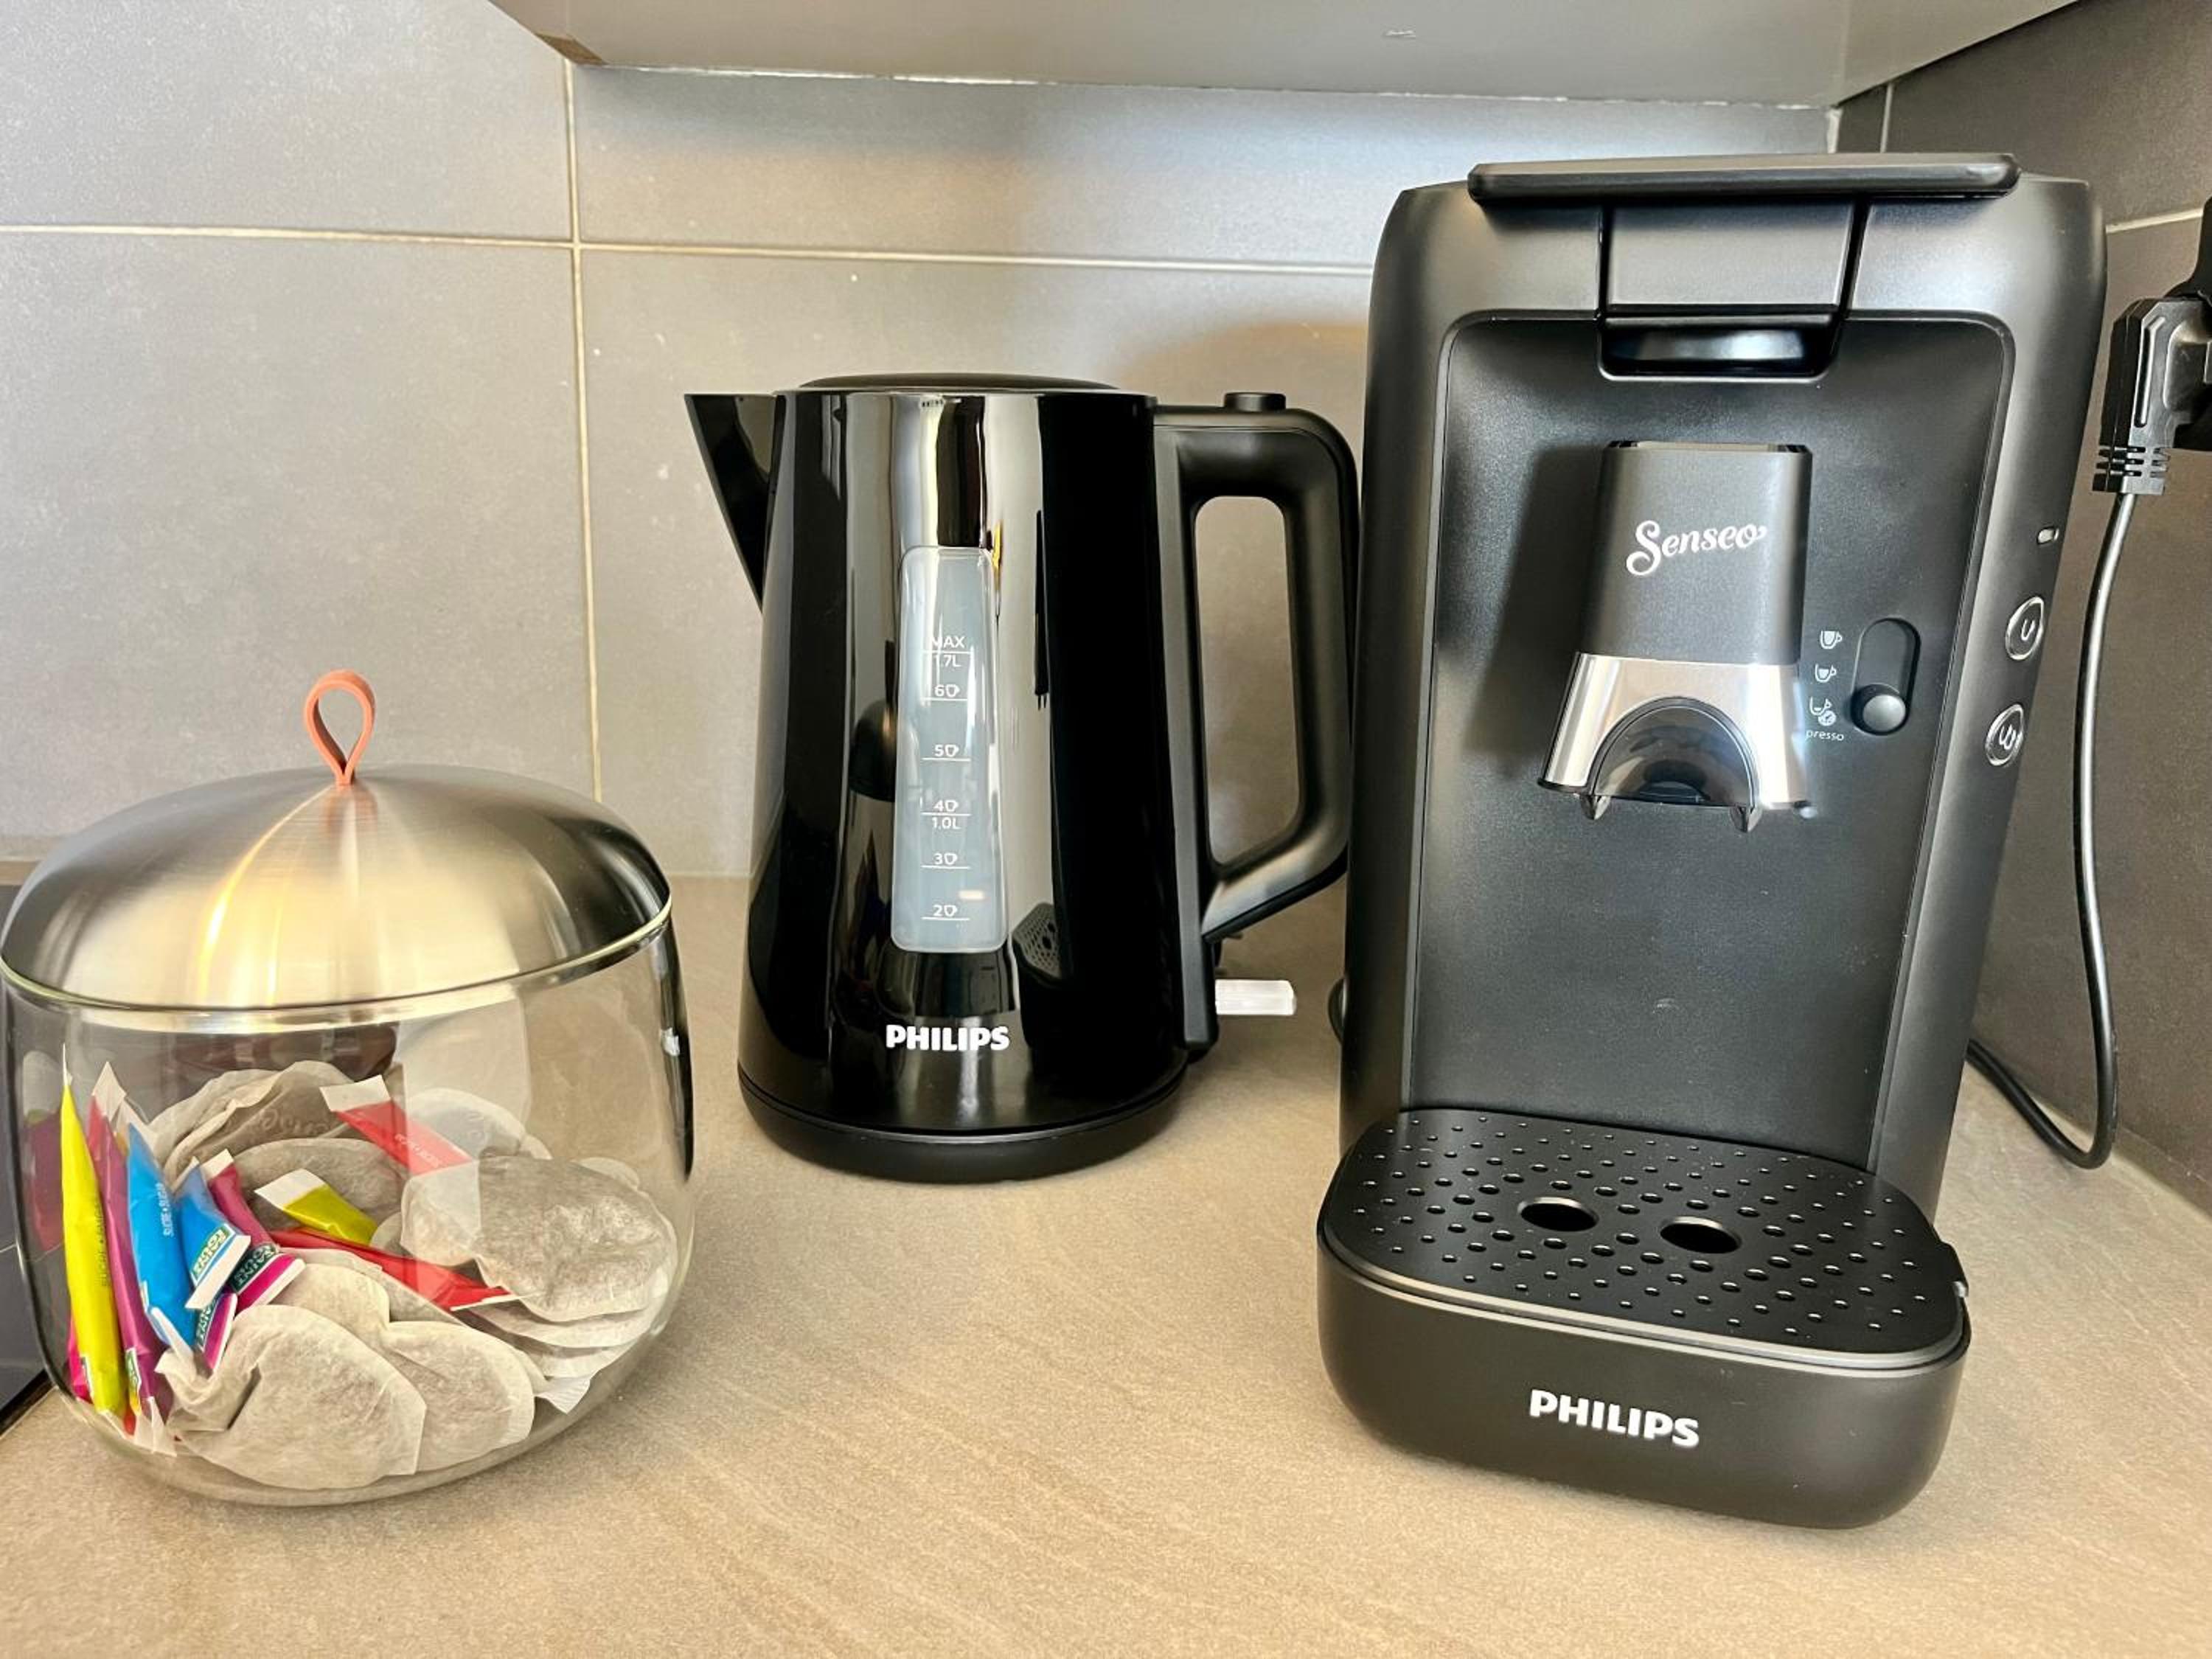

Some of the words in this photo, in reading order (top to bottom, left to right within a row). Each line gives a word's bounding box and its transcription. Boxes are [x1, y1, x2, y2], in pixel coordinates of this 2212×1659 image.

[1626, 520, 1767, 575] Senseo
[931, 636, 965, 648] MAX
[932, 816, 961, 830] 1.0L
[886, 1024, 1010, 1051] PHILIPS
[1529, 1389, 1700, 1447] PHILIPS
